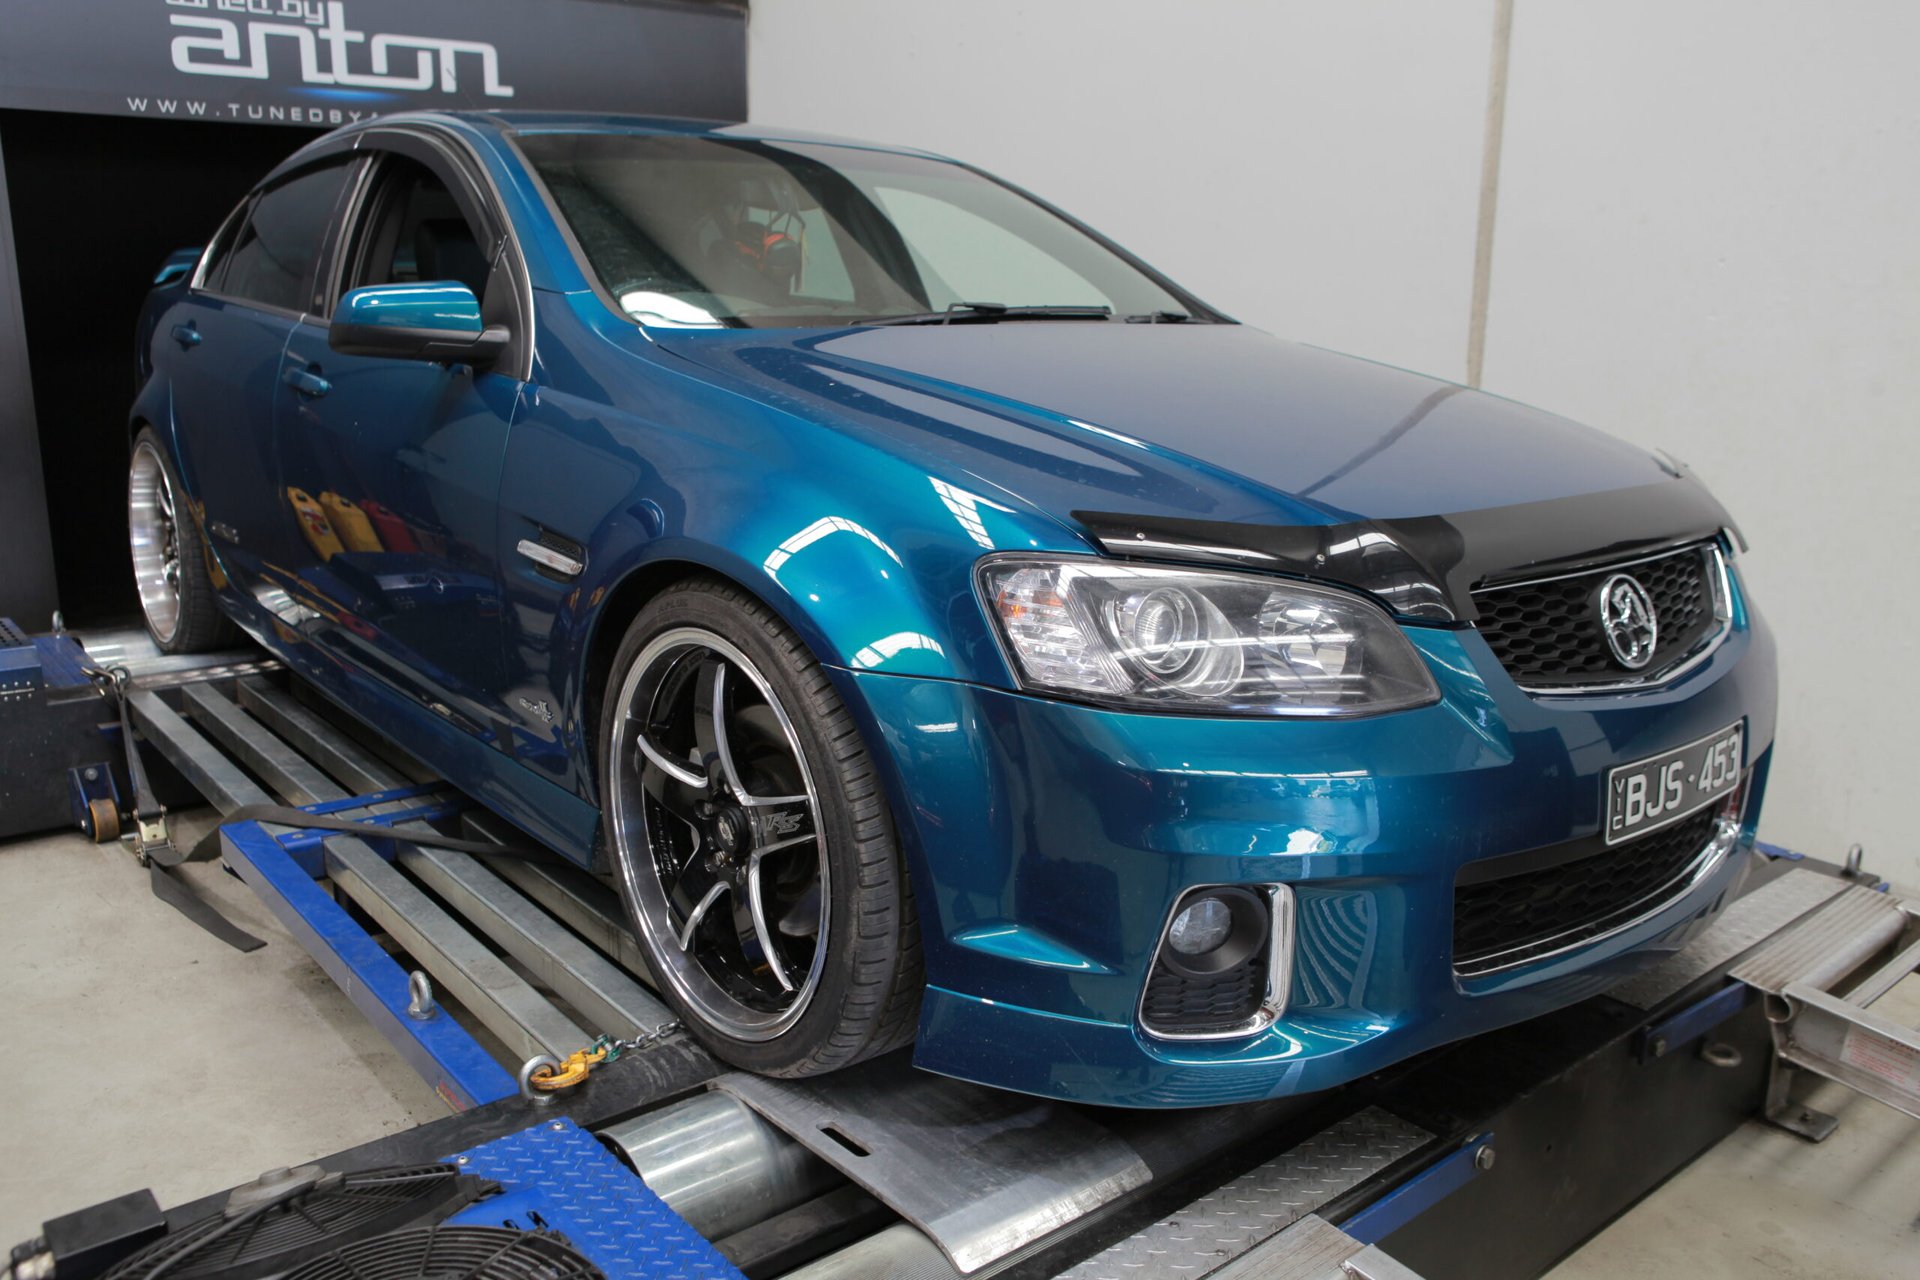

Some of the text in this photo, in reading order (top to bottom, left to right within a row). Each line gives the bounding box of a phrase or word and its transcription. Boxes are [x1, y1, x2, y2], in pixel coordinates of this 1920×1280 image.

[277, 0, 325, 25] by
[169, 1, 514, 97] anton
[1613, 779, 1625, 830] VIC
